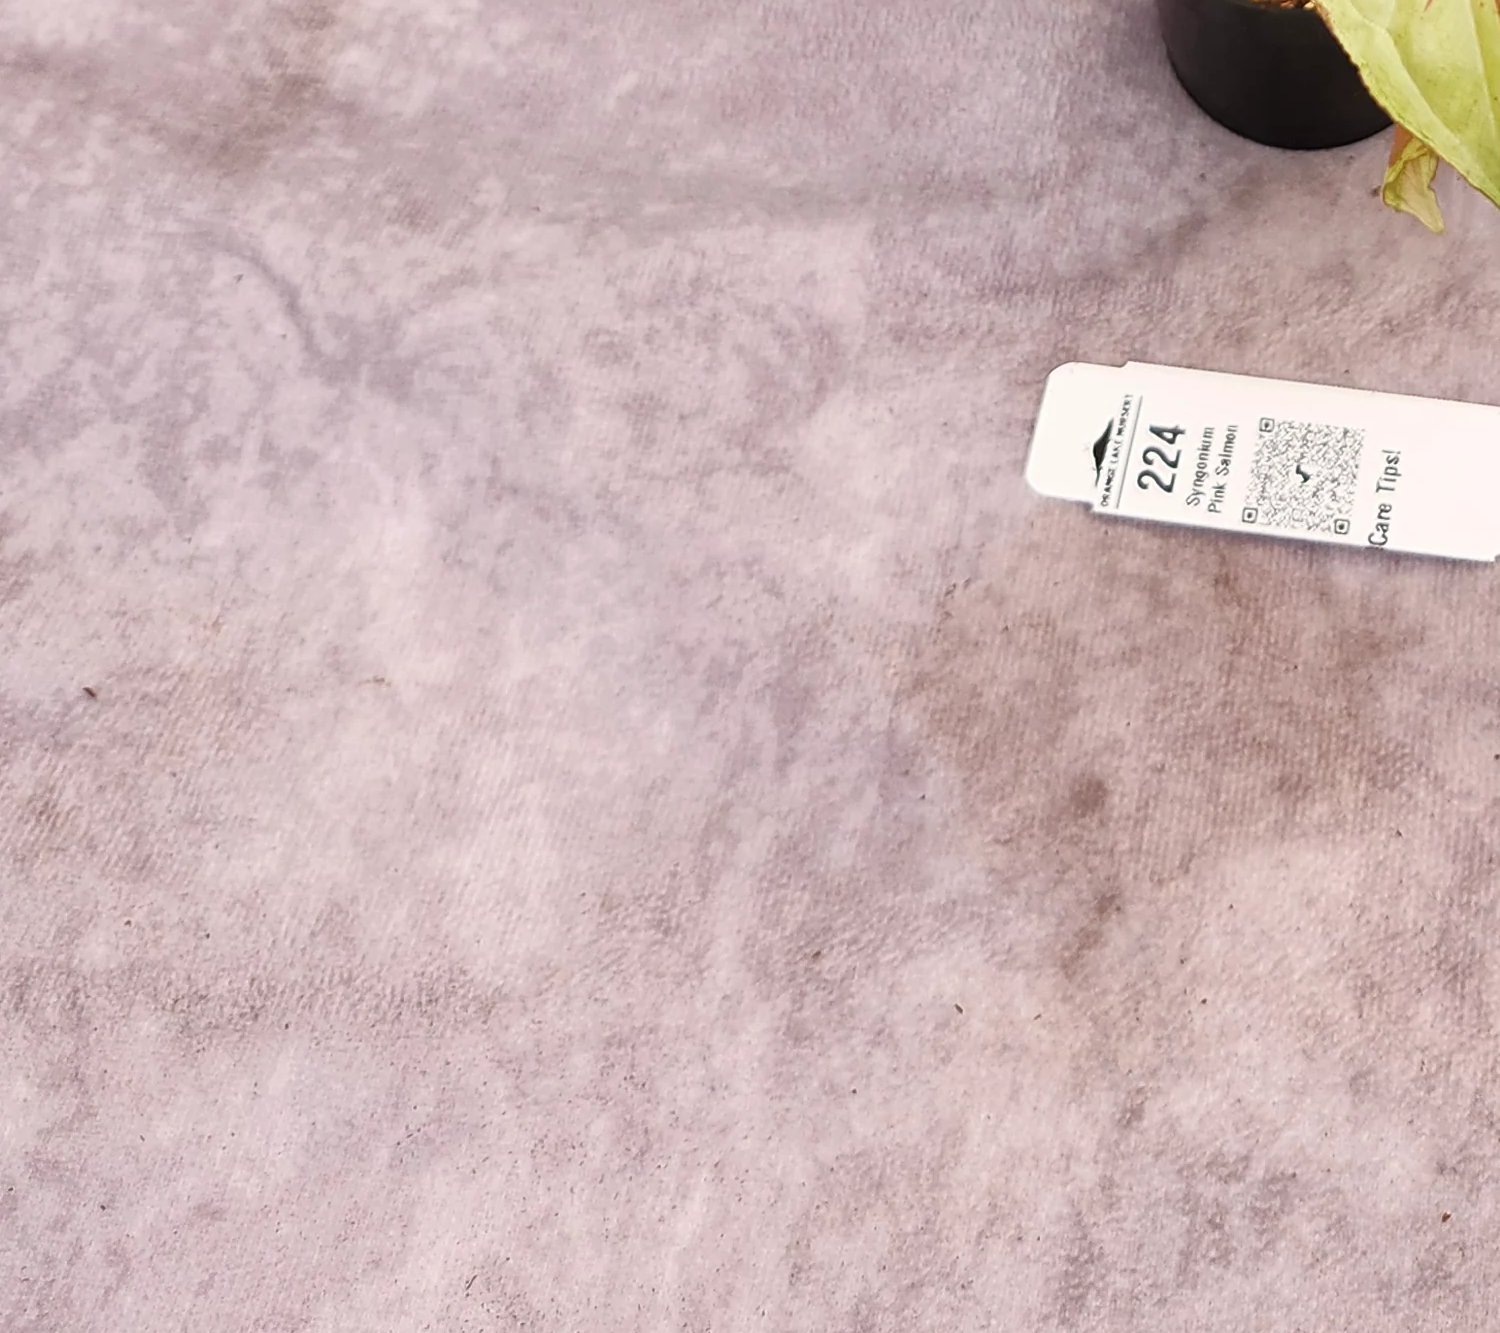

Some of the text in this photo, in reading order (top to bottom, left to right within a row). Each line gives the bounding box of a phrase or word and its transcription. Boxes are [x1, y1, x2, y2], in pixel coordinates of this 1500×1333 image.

[1137, 424, 1186, 493] 224
[1185, 426, 1215, 507] Syngonium
[1207, 425, 1239, 514] Pink Salmon
[1367, 448, 1402, 546] Care Tips!
